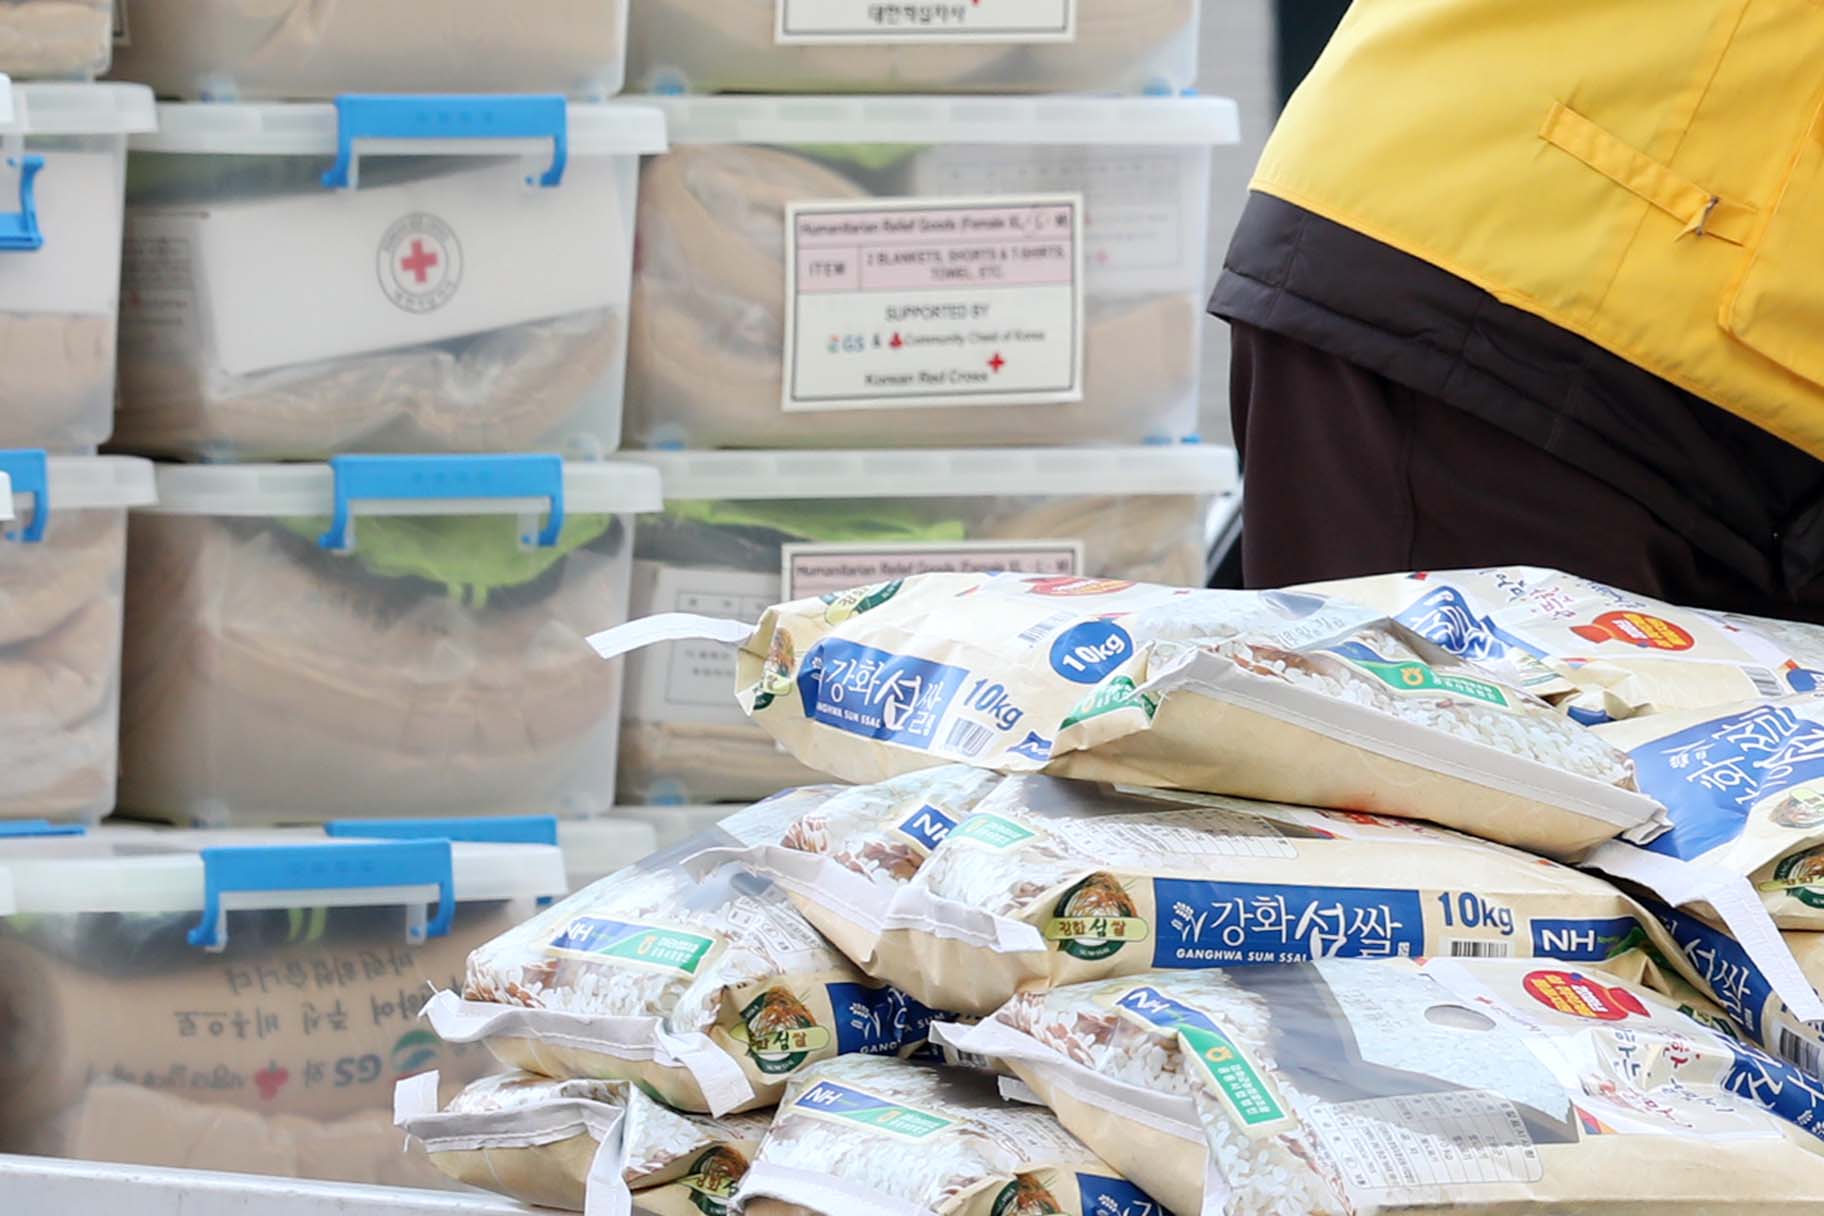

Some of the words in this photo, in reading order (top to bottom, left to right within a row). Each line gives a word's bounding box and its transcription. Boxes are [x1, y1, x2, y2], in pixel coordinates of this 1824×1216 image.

[867, 4, 966, 24] 대한적십자사
[802, 220, 879, 234] Humanitarian
[883, 219, 915, 232] Relief
[920, 218, 956, 231] Goods
[809, 262, 847, 276] ITEM
[885, 304, 967, 322] SUPPORTED
[971, 303, 990, 318] BY
[842, 334, 866, 352] GS
[865, 372, 914, 385] Korean
[918, 371, 944, 384] Red
[949, 371, 989, 384] Cross
[796, 564, 876, 578] Humanitarian
[880, 562, 914, 575] Relief
[1063, 631, 1126, 673] 10kg
[825, 655, 943, 737] 강화섬쌀
[963, 677, 1025, 731] 10kg
[1437, 891, 1515, 936] 10kg
[1210, 894, 1403, 960] 강화섬쌀
[1540, 929, 1596, 953] NH
[1175, 947, 1243, 962] GANGHWA
[1247, 951, 1276, 963] SUM
[806, 1086, 844, 1106] NH
